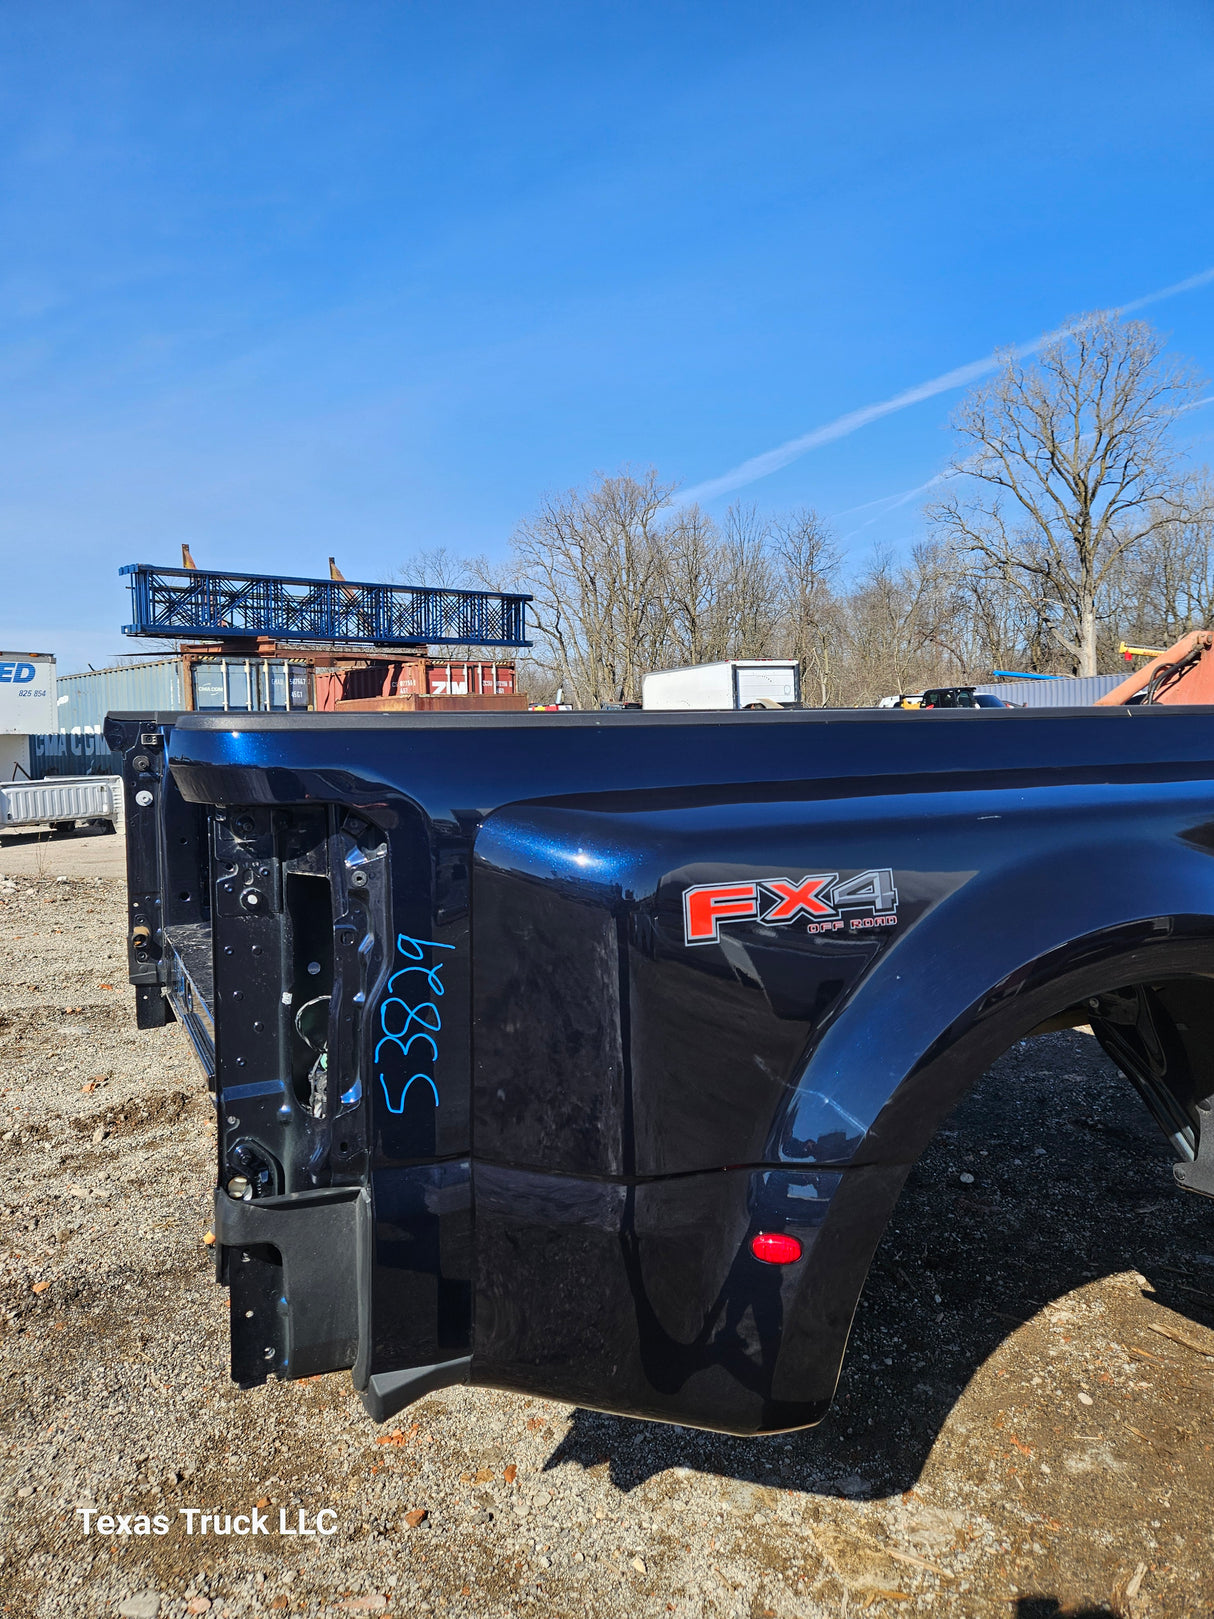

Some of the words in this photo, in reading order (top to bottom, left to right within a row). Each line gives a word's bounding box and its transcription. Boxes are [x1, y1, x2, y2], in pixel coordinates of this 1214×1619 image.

[18, 689, 32, 697] 825
[431, 681, 468, 694] ZIM
[35, 727, 67, 756] CMA
[682, 868, 899, 947] FX4
[807, 919, 845, 934] OFF
[850, 914, 899, 930] ROAD
[374, 933, 456, 1114] 53829
